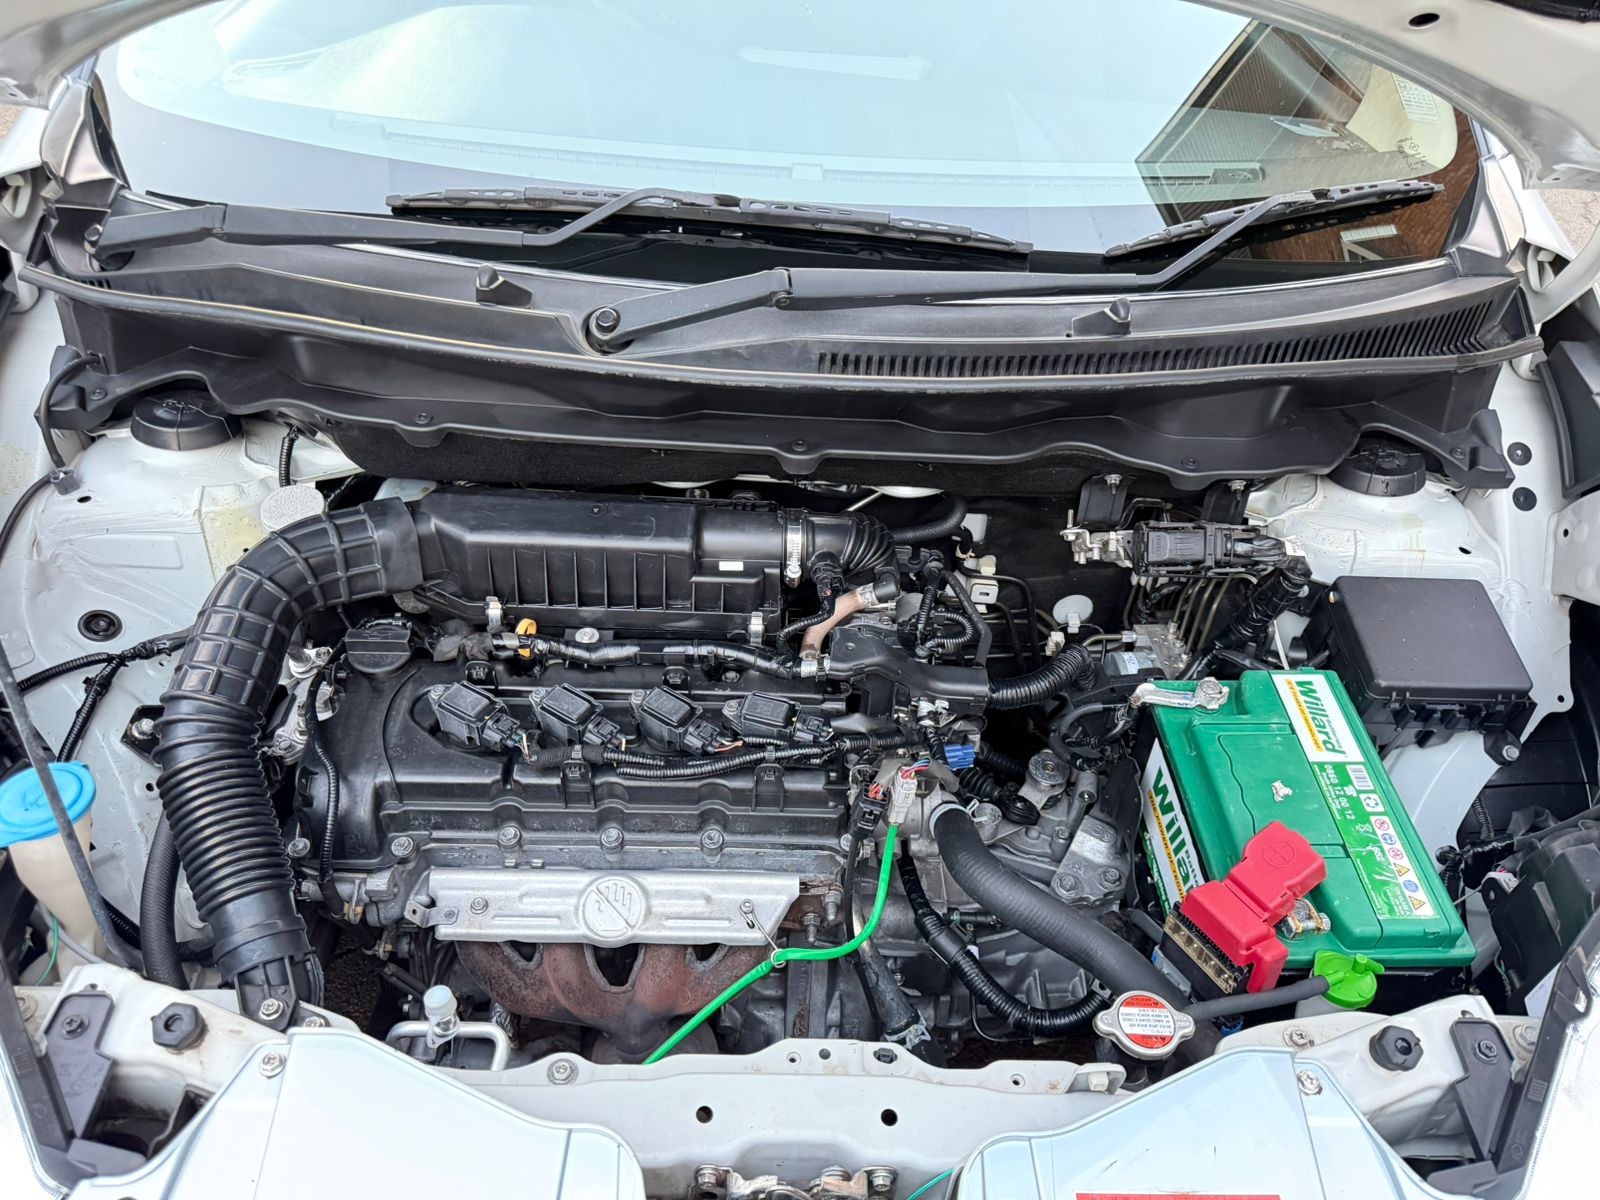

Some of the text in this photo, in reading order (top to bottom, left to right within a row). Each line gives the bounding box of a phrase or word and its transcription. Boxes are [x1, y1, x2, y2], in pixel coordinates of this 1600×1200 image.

[1294, 679, 1346, 754] Willard
[1323, 764, 1355, 820] 0860 12 00 12
[1149, 795, 1157, 813] THE
[1155, 815, 1170, 850] POWER
[1167, 852, 1174, 866] OF
